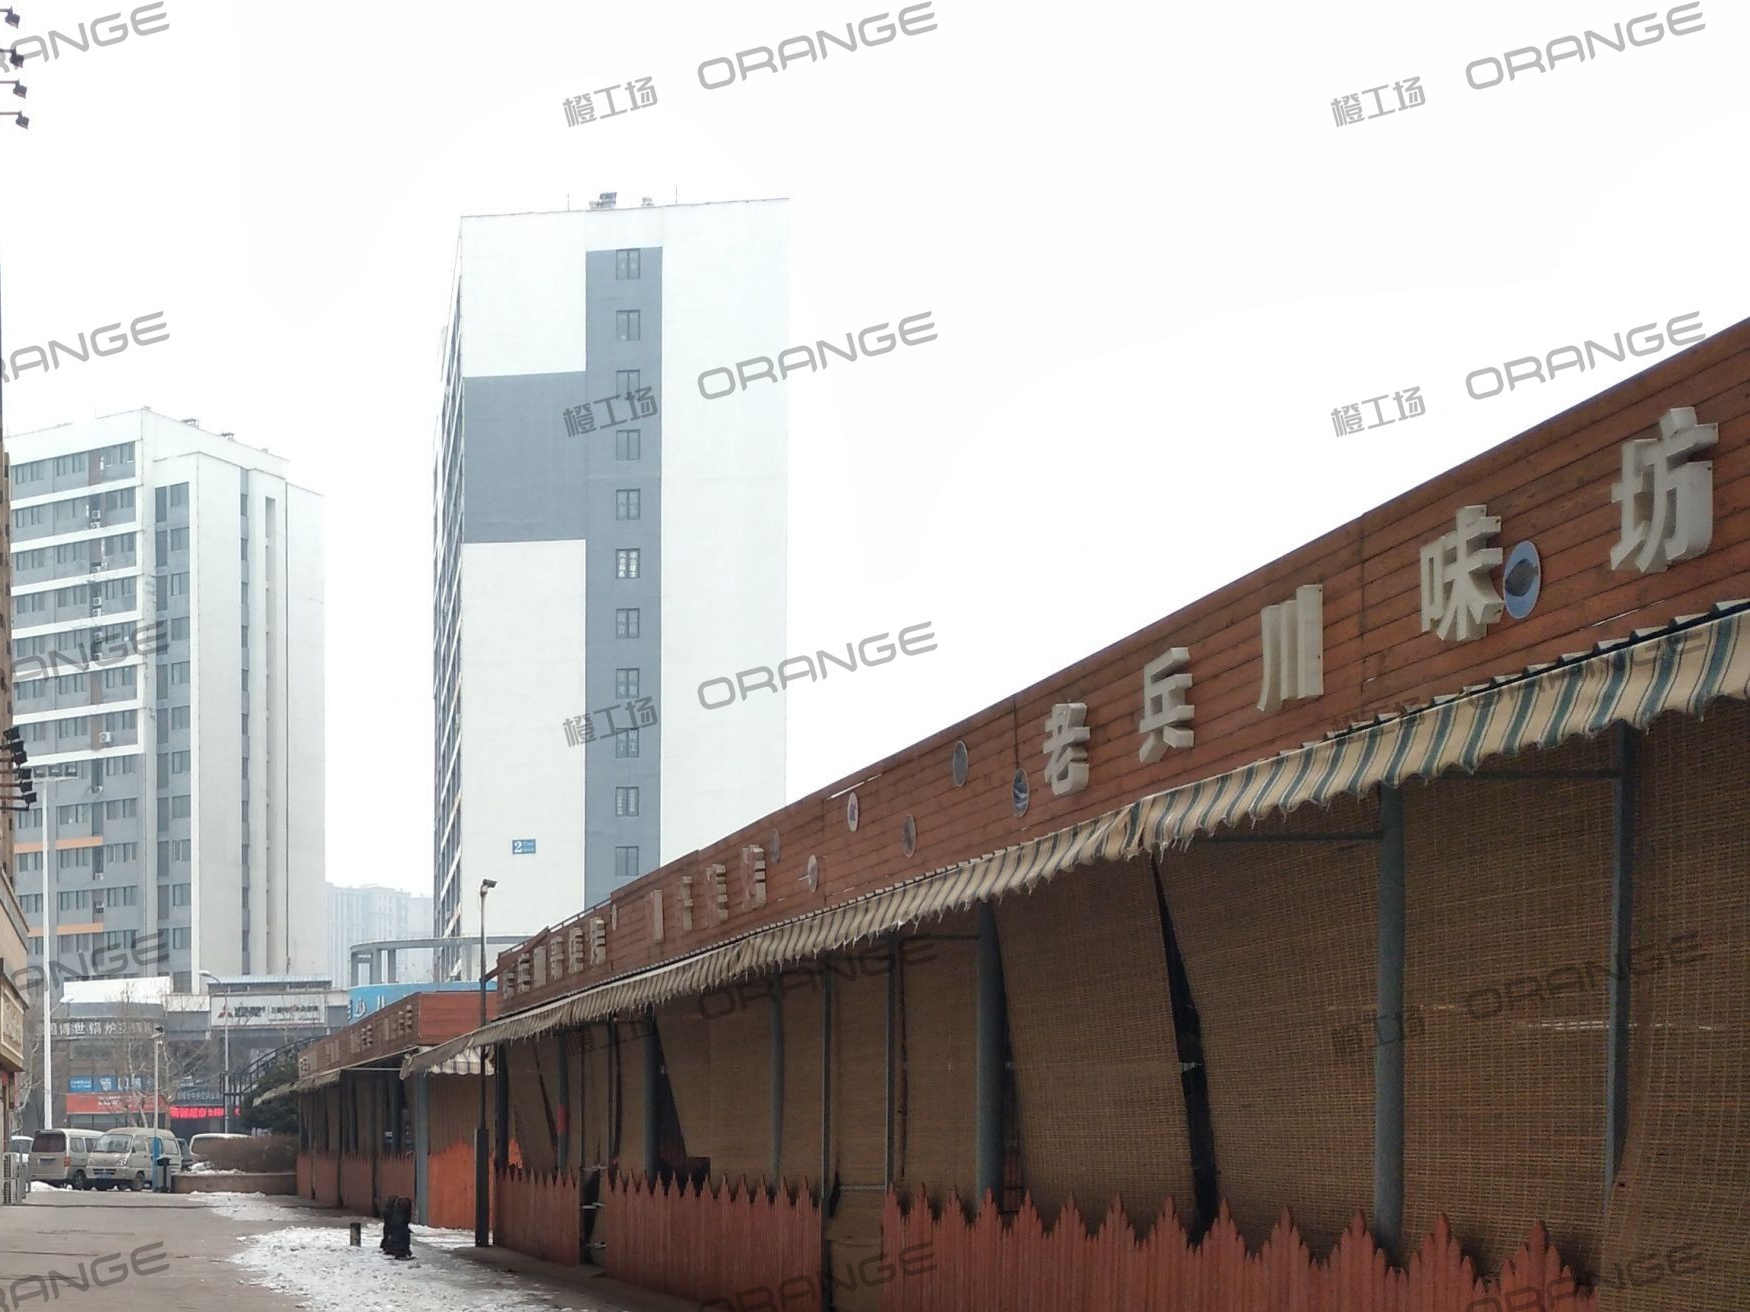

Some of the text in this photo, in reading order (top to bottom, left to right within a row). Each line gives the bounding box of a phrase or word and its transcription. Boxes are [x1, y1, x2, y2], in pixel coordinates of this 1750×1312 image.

[1043, 407, 1719, 797] 老兵川味坊
